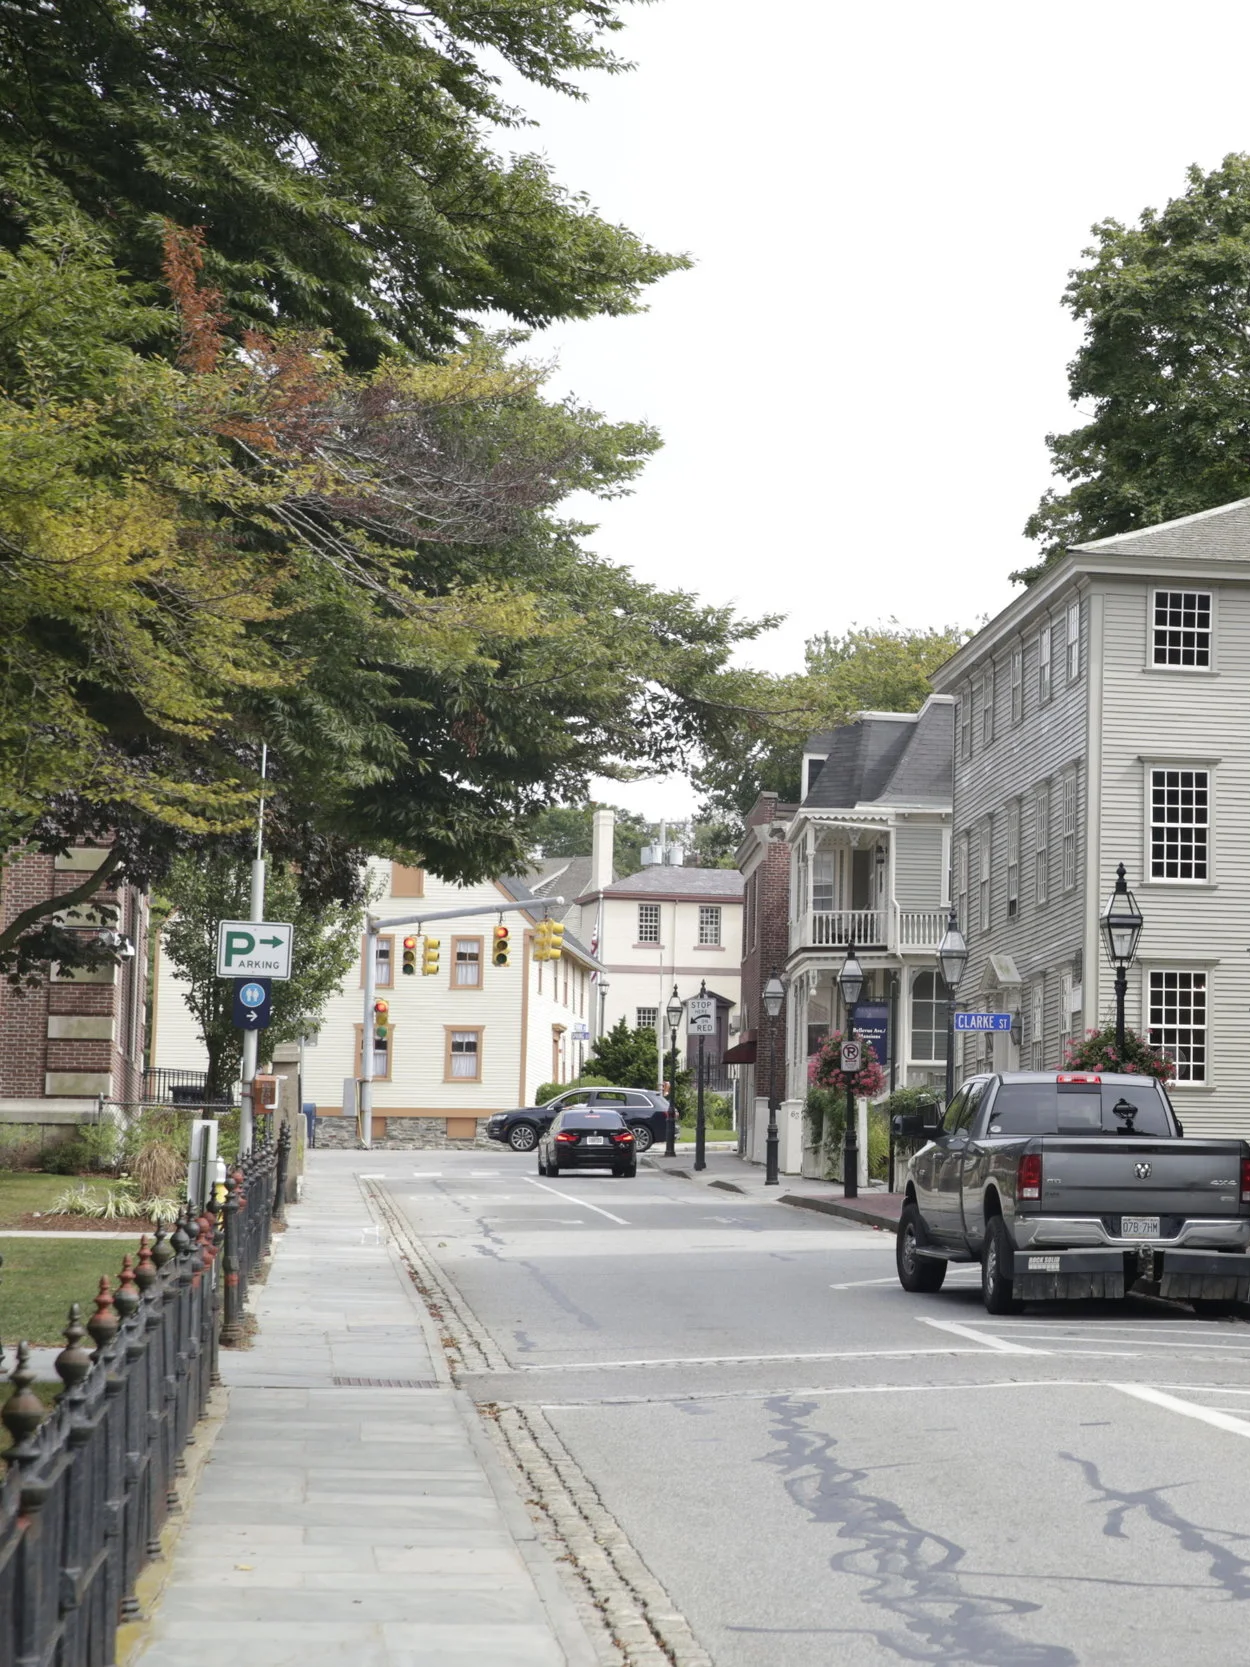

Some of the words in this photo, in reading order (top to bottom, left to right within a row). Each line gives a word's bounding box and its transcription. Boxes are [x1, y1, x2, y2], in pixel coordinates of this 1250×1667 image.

[691, 1001, 712, 1009] STOP
[958, 1015, 995, 1029] CLARKE
[998, 1018, 1008, 1029] ST
[696, 1024, 713, 1032] RED
